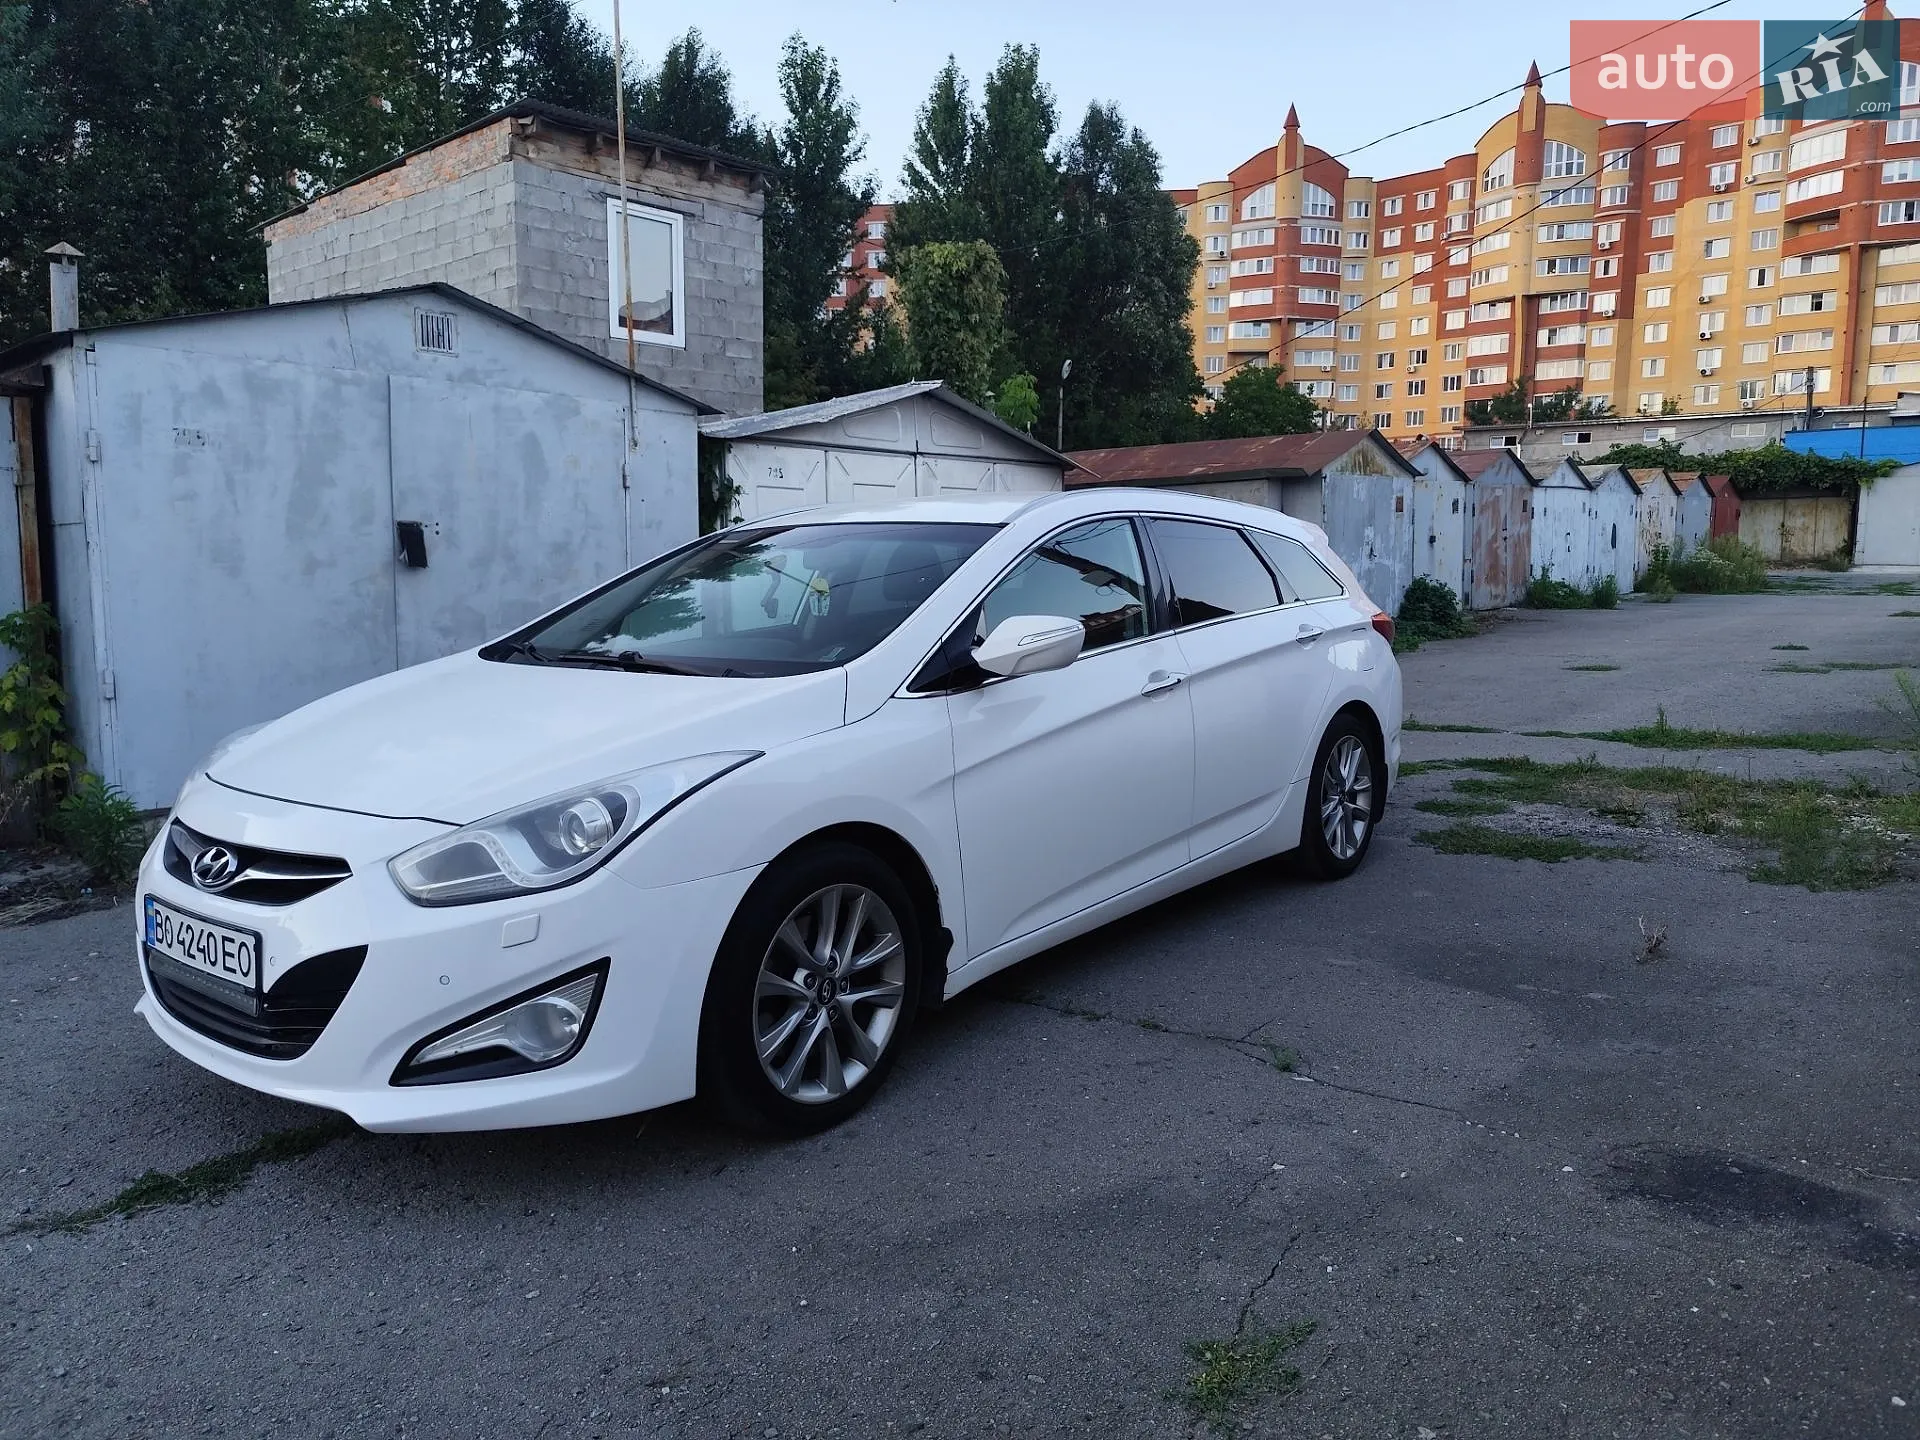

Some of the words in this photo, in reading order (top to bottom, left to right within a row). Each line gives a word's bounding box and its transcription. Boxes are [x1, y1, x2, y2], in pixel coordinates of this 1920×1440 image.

[154, 908, 174, 949] BO
[177, 921, 218, 967] 4240
[221, 935, 251, 978] EO
